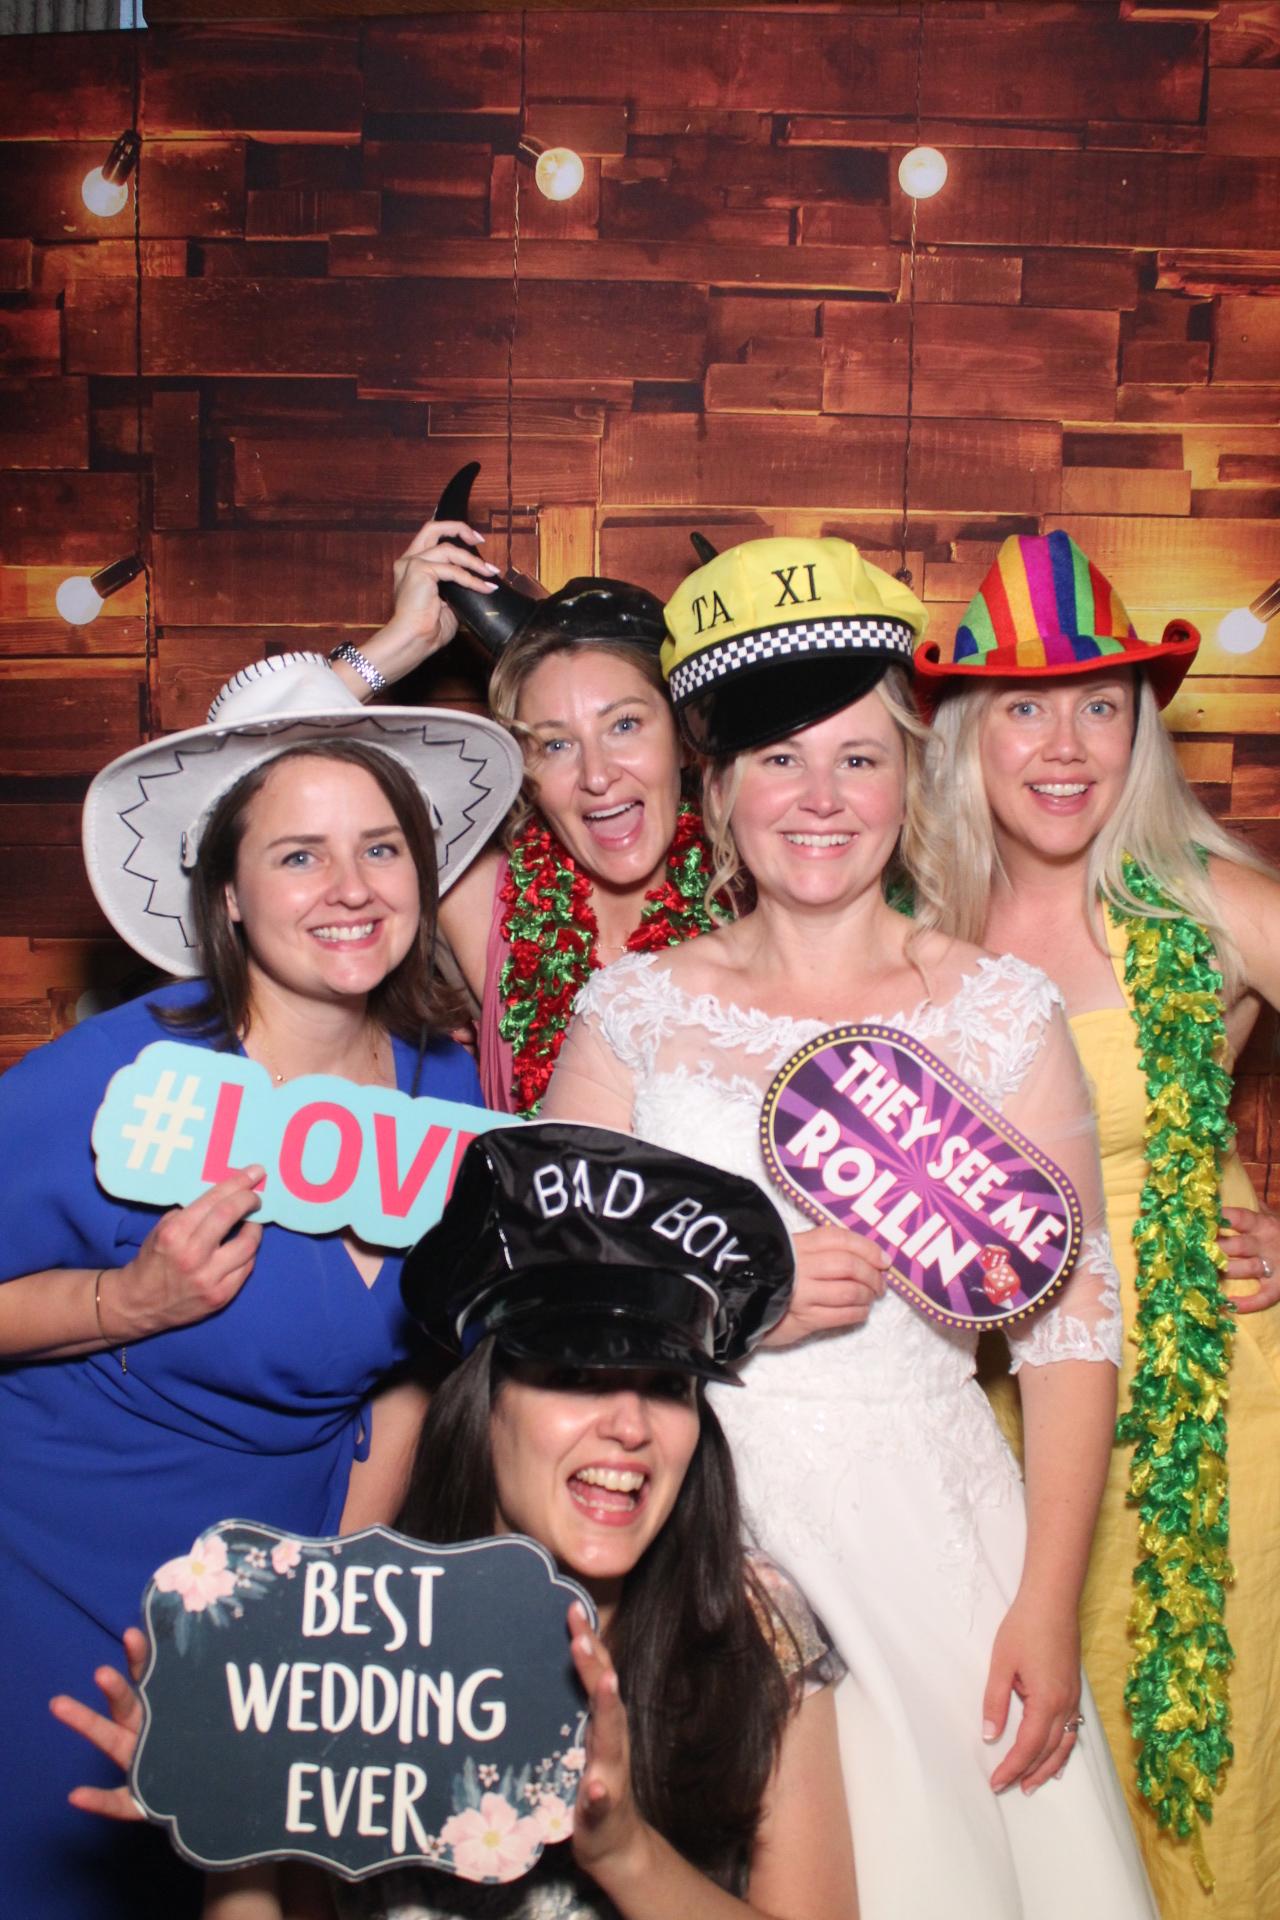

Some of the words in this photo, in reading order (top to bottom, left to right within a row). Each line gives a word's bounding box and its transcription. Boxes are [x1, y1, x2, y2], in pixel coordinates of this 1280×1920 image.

[121, 1069, 482, 1219] #LOV
[785, 1108, 983, 1288] ROLLIN
[833, 1044, 942, 1151] THEY
[926, 1135, 1009, 1212] SEE
[989, 1192, 1066, 1262] ME
[533, 1158, 645, 1220] BAD
[651, 1197, 750, 1273] BOY
[302, 1561, 446, 1652] BEST
[225, 1661, 507, 1746] WEDDING
[285, 1762, 431, 1855] EVER
